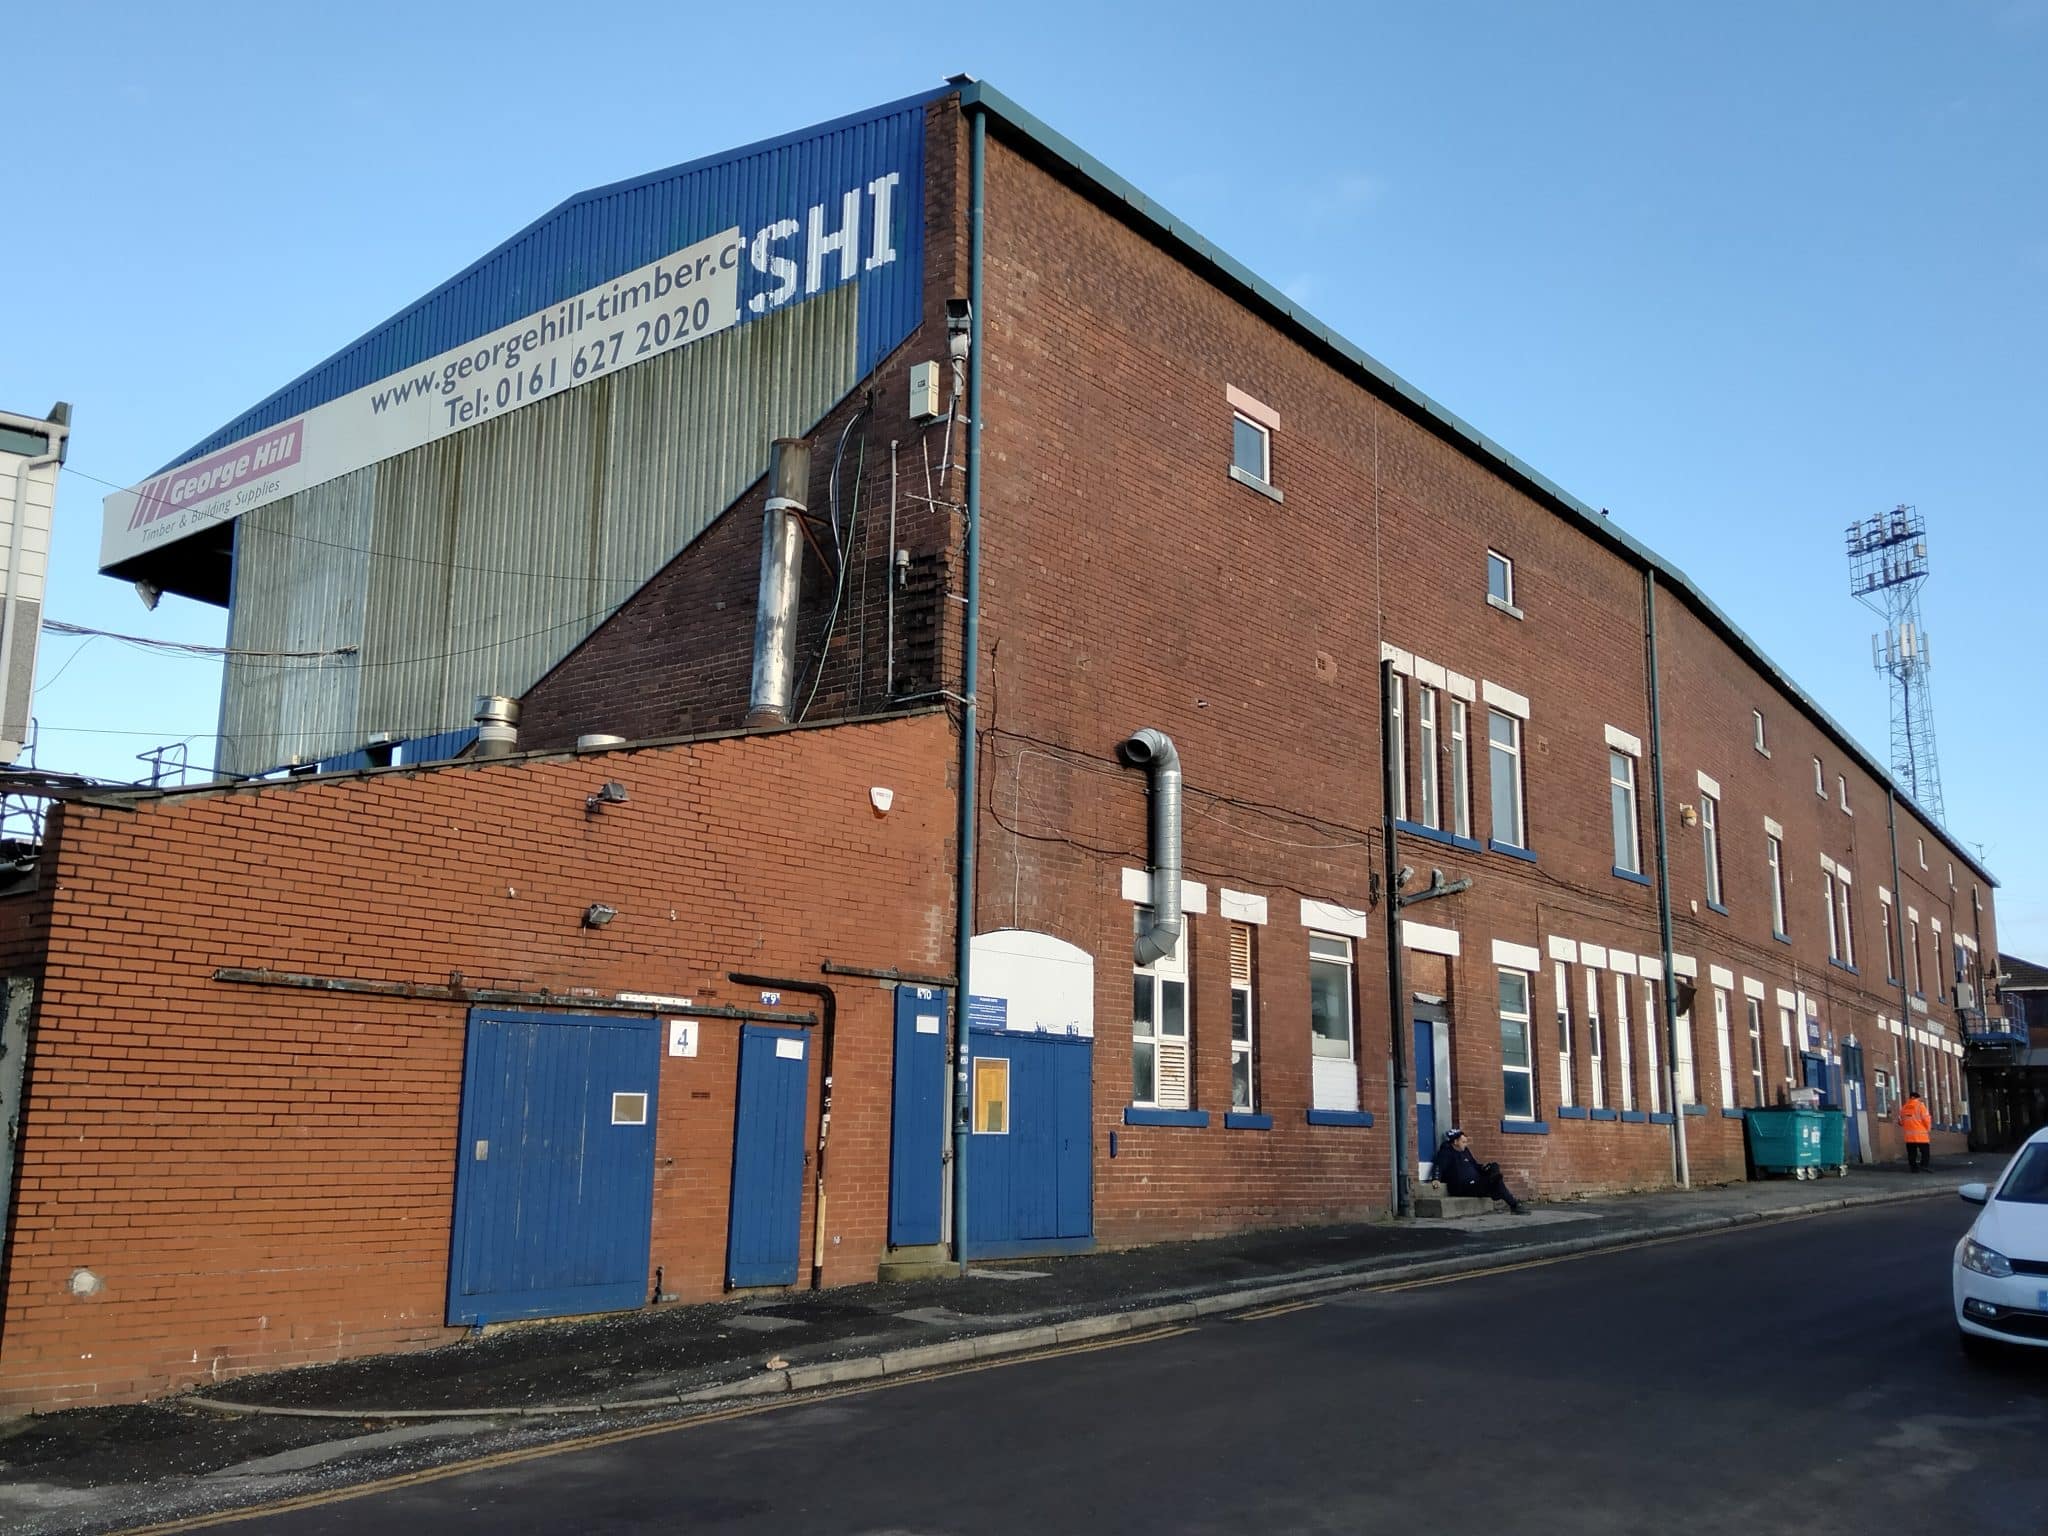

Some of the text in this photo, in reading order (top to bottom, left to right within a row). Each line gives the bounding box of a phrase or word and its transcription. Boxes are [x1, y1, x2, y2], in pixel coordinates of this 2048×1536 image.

[736, 172, 900, 321] SHI
[445, 297, 710, 427] Tel: 0161 627 2020
[170, 432, 296, 505] George Hill
[141, 479, 281, 543] Timber & Building Supplies
[677, 1028, 689, 1047] 4
